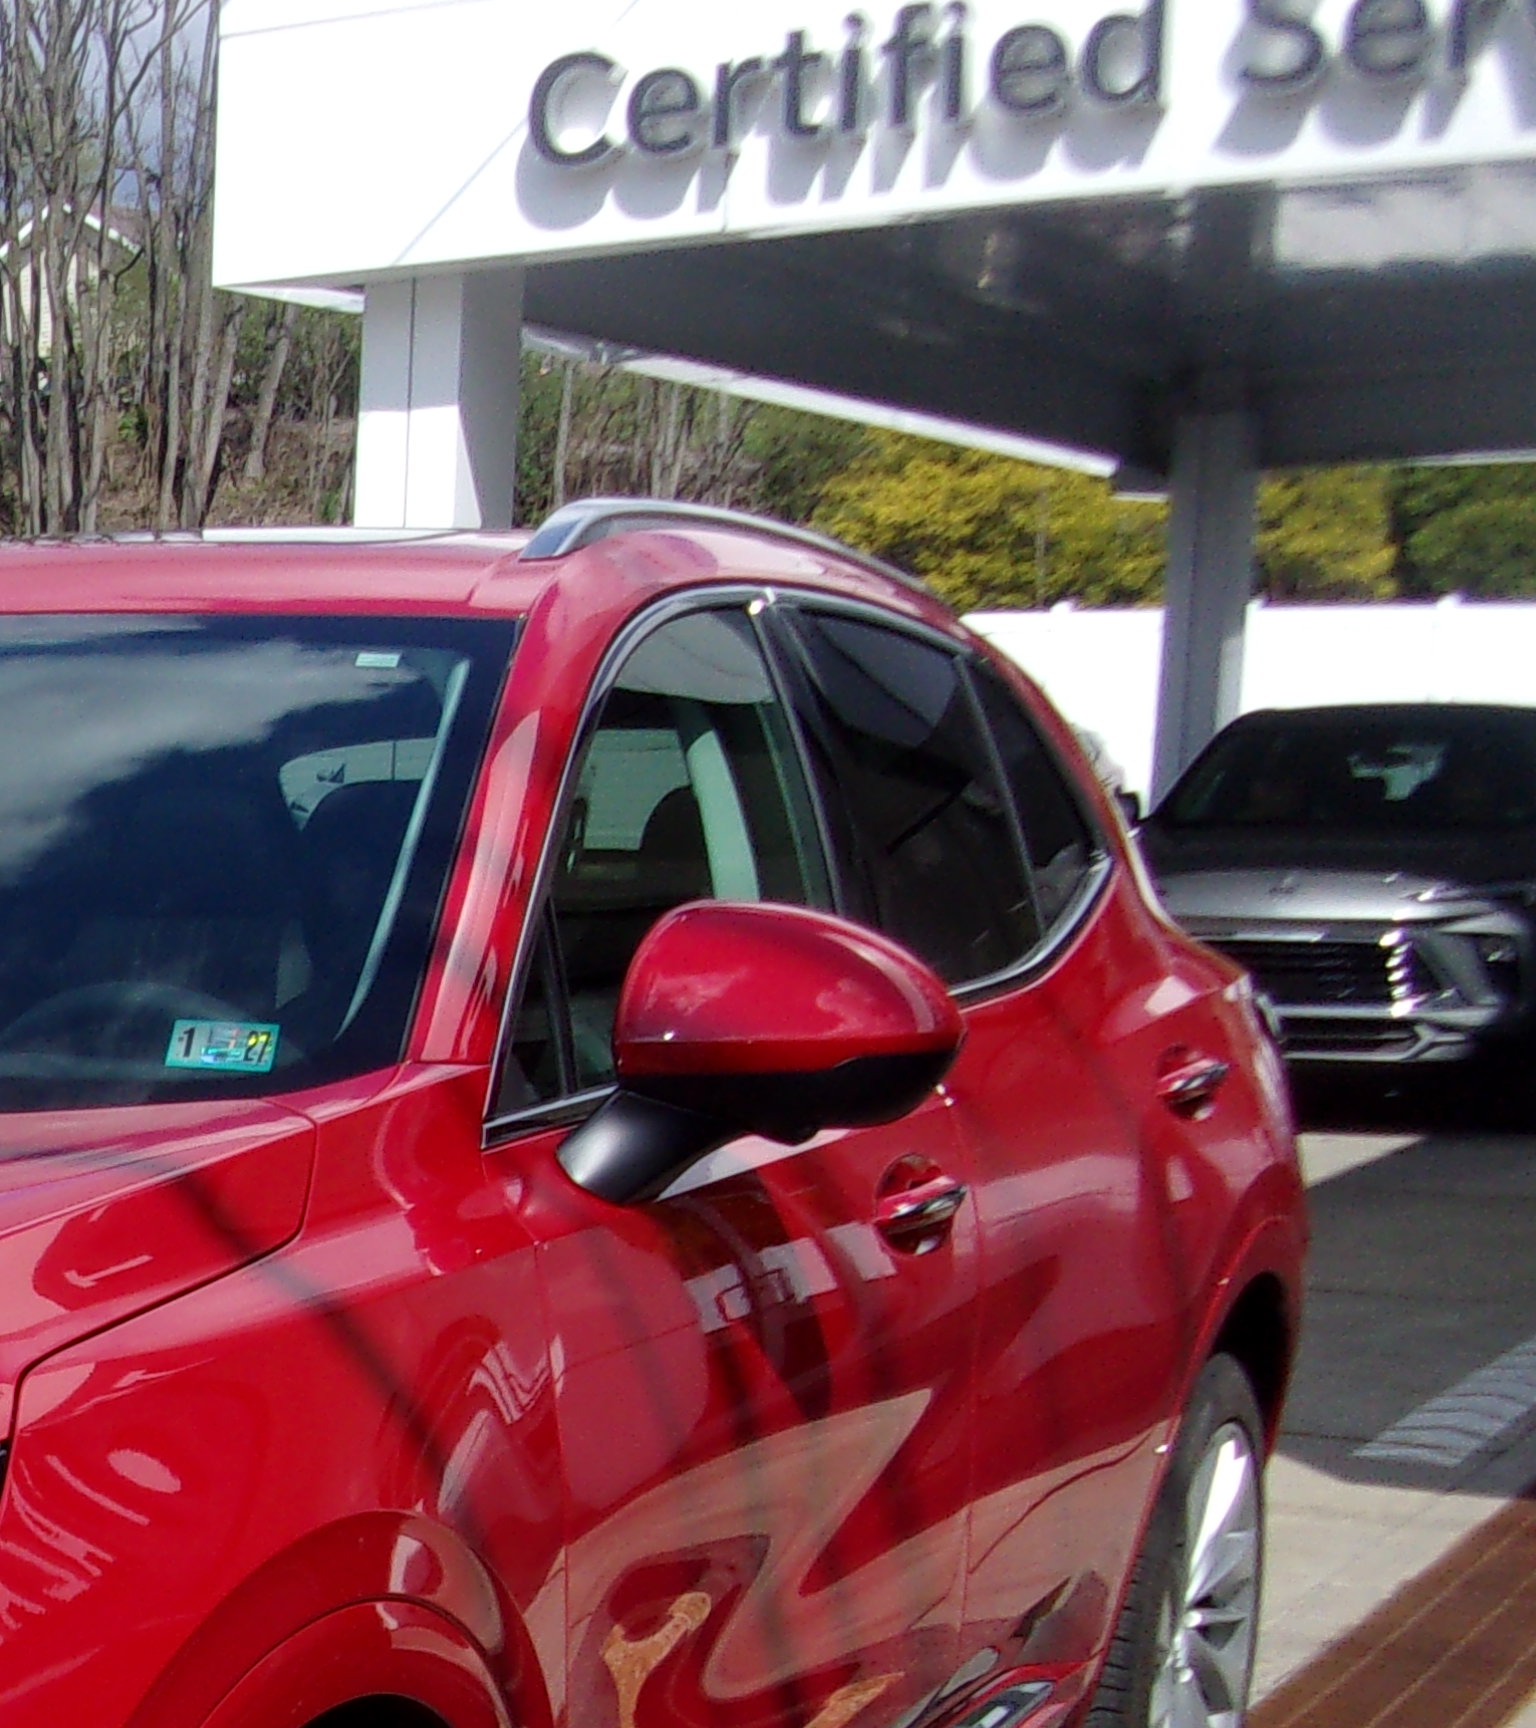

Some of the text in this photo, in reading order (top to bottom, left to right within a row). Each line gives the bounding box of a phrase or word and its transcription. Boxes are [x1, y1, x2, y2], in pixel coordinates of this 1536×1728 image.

[529, 0, 1536, 167] Certified Ser
[243, 1030, 272, 1063] 27
